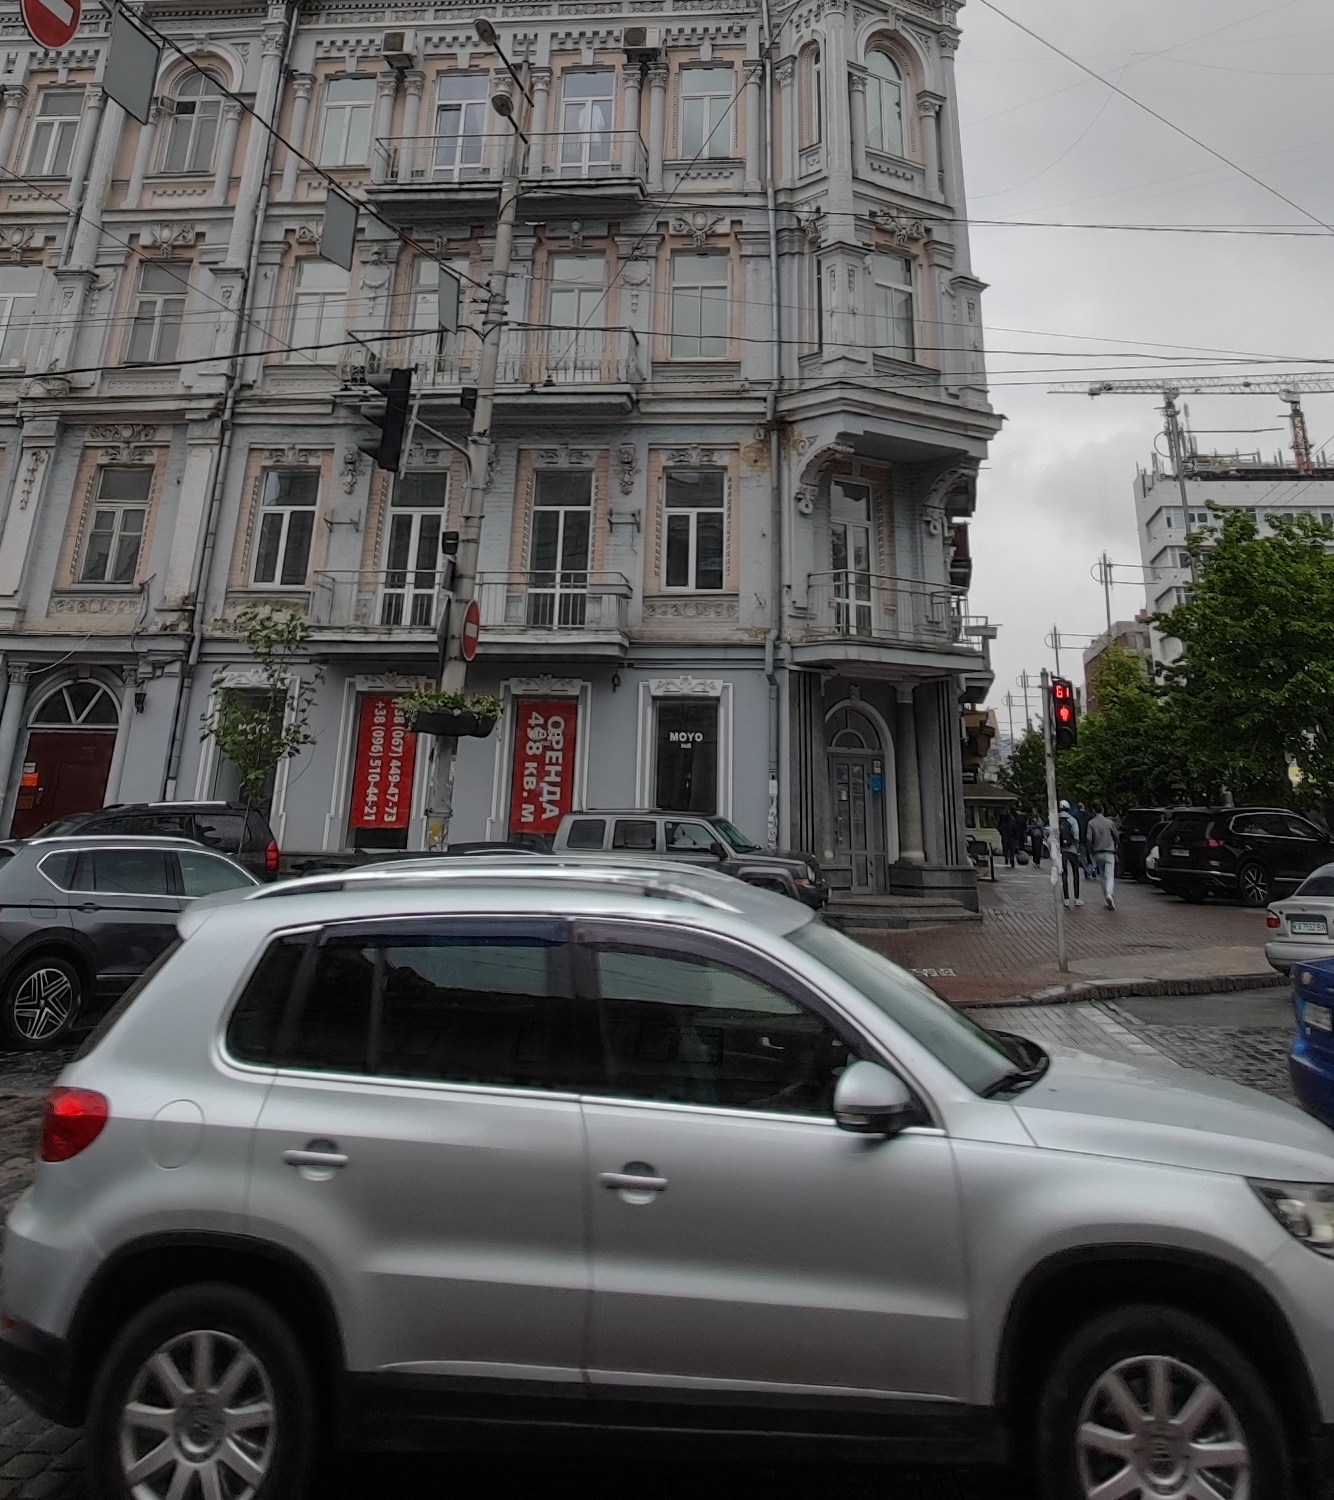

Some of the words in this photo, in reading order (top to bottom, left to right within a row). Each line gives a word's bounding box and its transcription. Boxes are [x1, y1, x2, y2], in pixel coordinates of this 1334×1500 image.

[374, 701, 387, 724] +38
[369, 726, 386, 757] (096)
[388, 726, 405, 757] (067)
[669, 731, 703, 742] MOYO
[539, 715, 565, 820] ОРЕНДА
[363, 759, 382, 821] 510-44-21
[384, 759, 402, 822] 449-47-73
